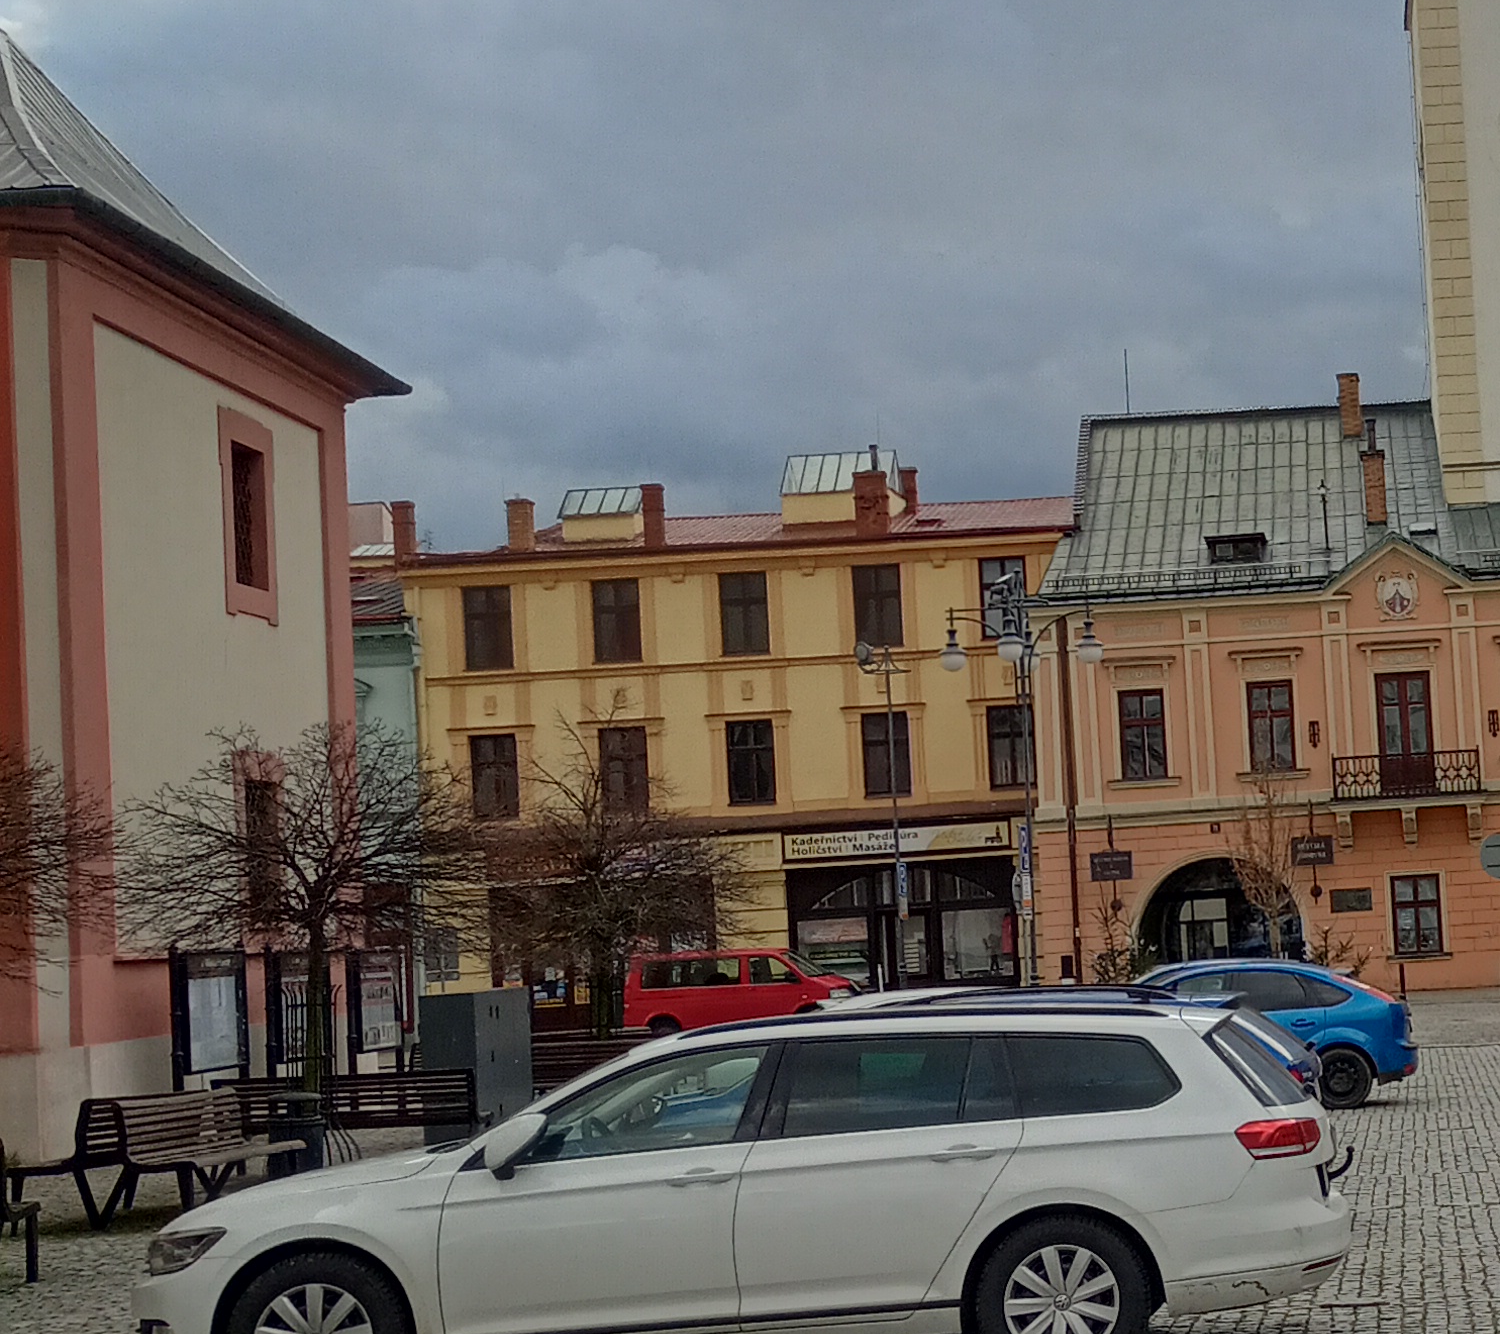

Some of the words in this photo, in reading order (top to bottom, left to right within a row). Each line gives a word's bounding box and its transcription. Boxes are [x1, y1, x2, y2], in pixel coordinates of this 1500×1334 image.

[791, 834, 858, 847] Kadeřnictví
[868, 830, 919, 842] Pediúra
[791, 842, 843, 857] Holičství
[852, 840, 896, 853] Masáže
